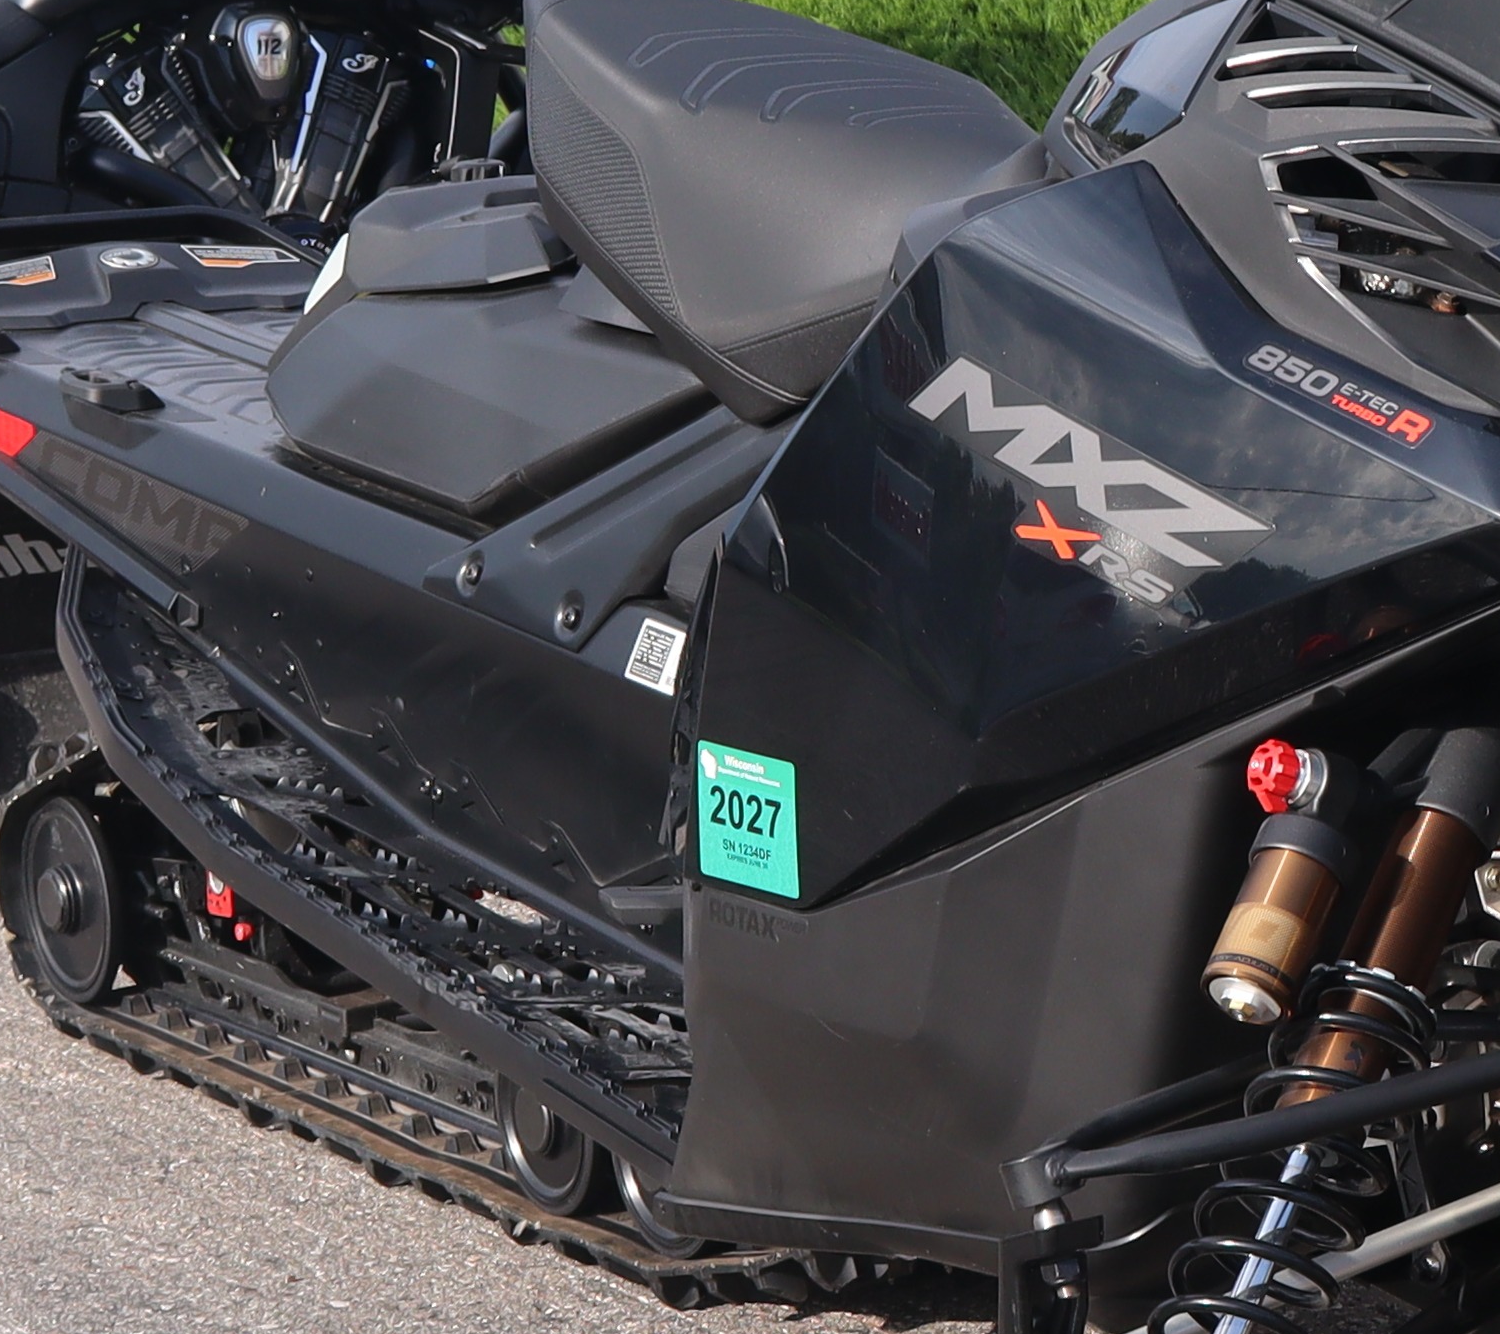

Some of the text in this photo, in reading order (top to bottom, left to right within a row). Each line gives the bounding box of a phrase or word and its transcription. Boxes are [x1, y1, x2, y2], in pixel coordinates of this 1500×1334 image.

[257, 38, 282, 55] 112
[1247, 344, 1399, 417] 850 E-TEC
[1330, 394, 1431, 444] TURBO R
[907, 356, 1272, 567] MXZ
[723, 754, 765, 775] Wisconsin
[709, 784, 782, 839] 2027
[722, 838, 772, 862] SN 1234DF
[708, 897, 780, 943] ROTAX
